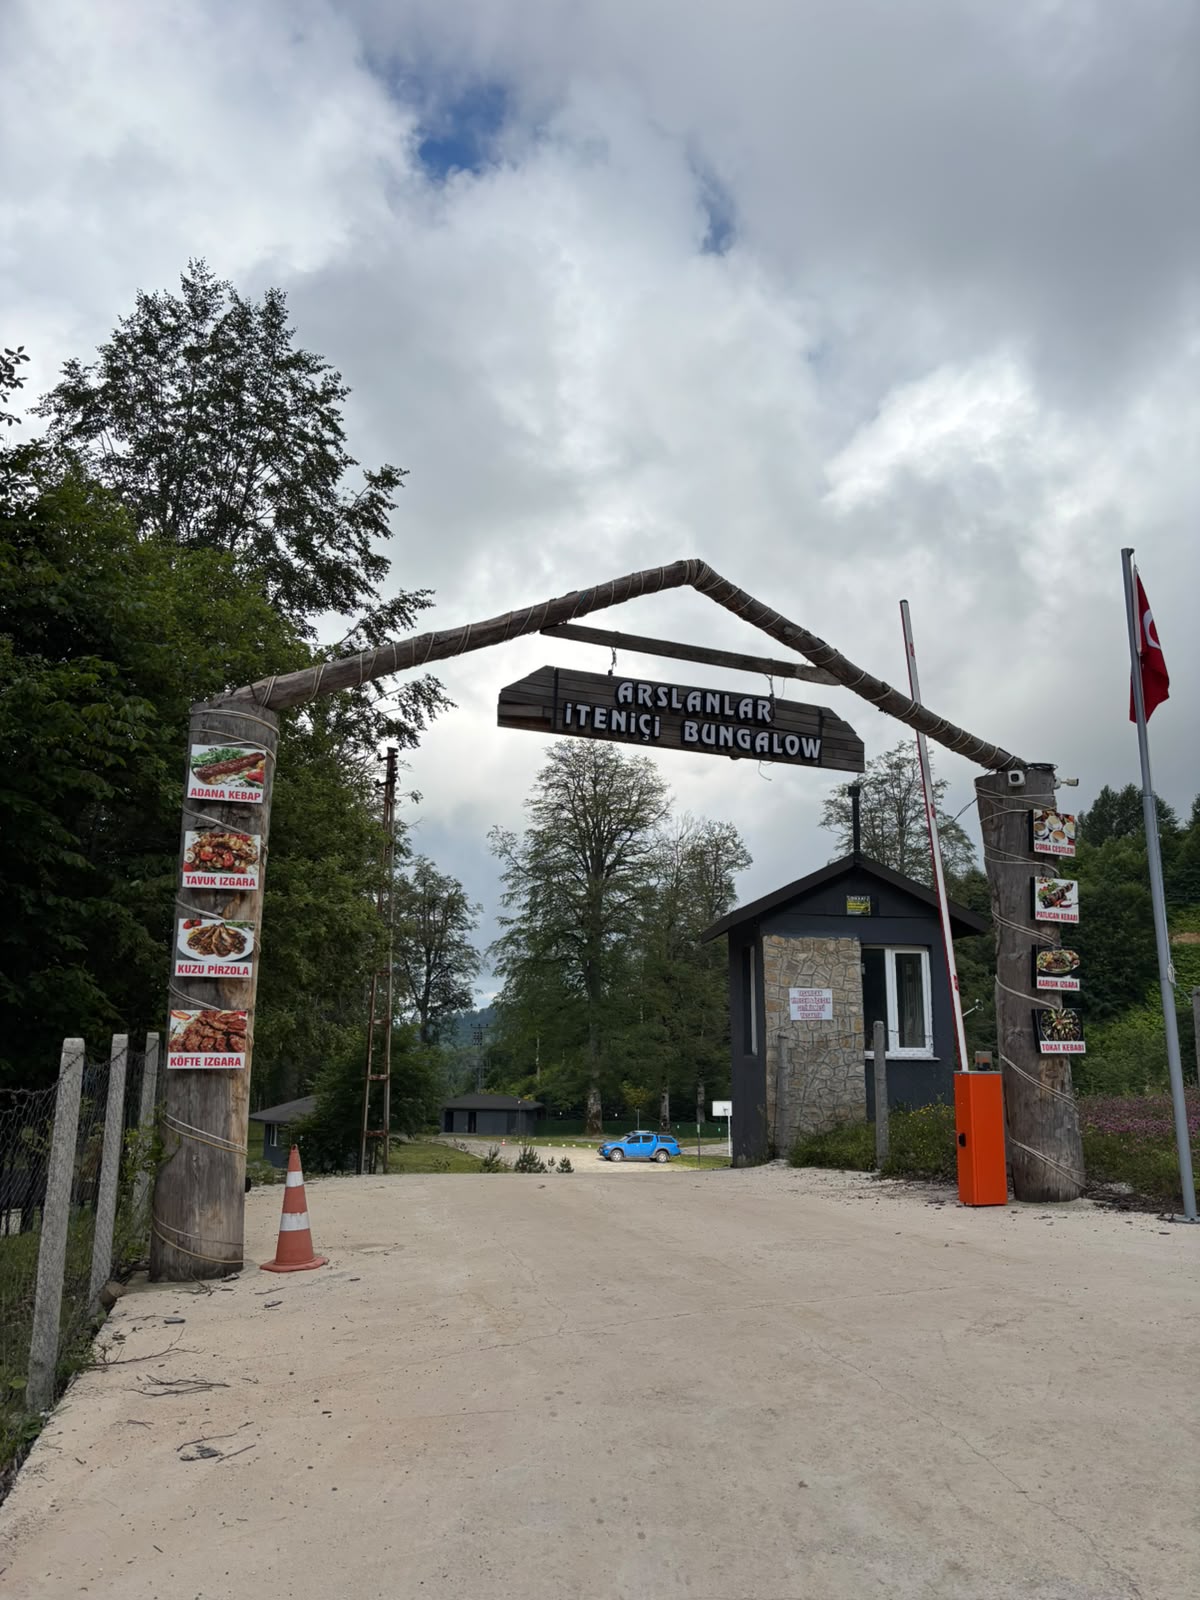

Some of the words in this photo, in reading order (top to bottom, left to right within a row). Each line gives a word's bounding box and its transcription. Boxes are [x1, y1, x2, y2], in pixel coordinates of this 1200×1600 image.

[617, 682, 773, 723] ARSLANLAR
[684, 720, 821, 760] BUNGALOW
[191, 788, 225, 799] ADANA
[229, 790, 261, 801] KEBAP
[185, 875, 216, 886] TAVUK
[219, 876, 256, 887] IZGARA
[177, 964, 205, 975] KUZU
[208, 963, 249, 976] PİRZOLA
[1041, 1043, 1060, 1052] TOKAT
[169, 1055, 201, 1067] KÖFTE
[204, 1056, 241, 1067] IZGARA
